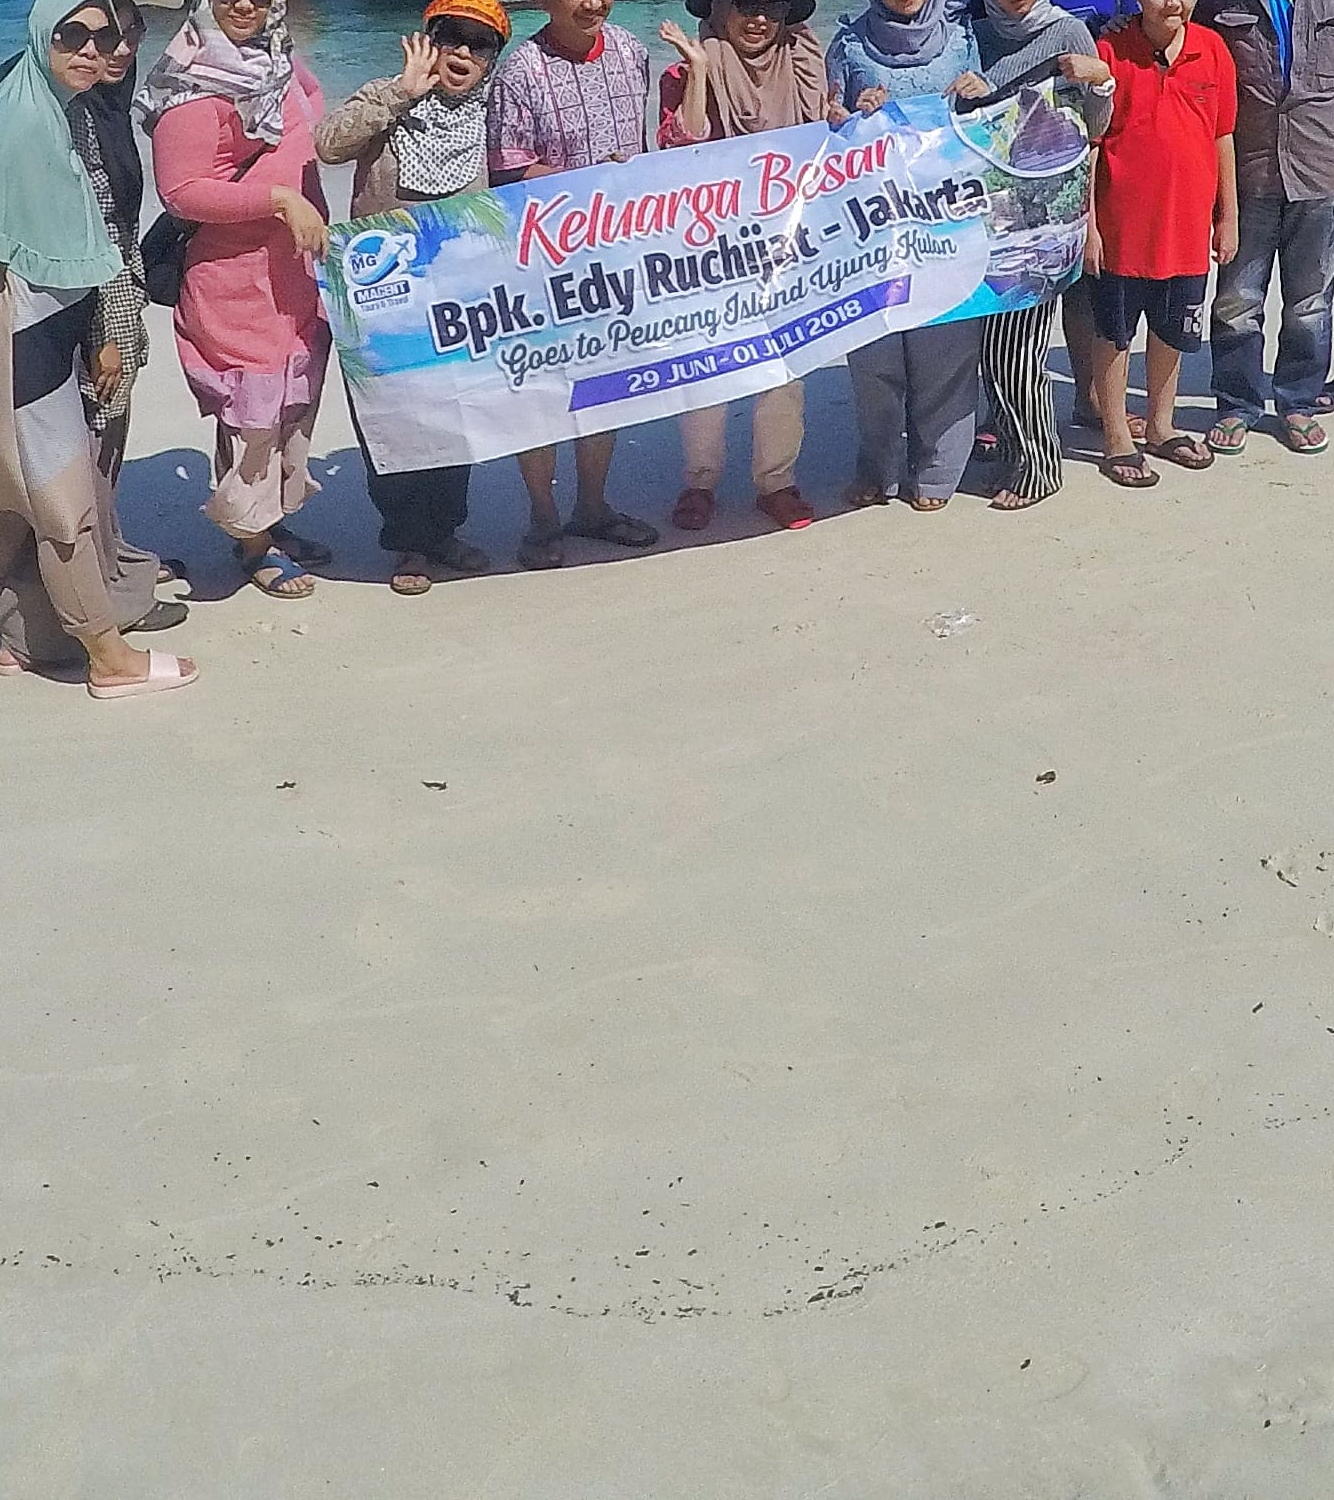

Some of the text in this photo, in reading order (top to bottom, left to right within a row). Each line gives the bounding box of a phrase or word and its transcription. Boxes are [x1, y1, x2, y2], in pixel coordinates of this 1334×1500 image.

[351, 255, 377, 270] MG
[431, 285, 545, 353] Bpk.
[549, 262, 634, 316] Edy
[643, 223, 820, 297] Ruchijat
[845, 178, 986, 242] Jakarta
[519, 134, 895, 266] Keluarga Besar
[501, 229, 957, 386] Goes to Peucang Island Ujung Kulon
[627, 370, 660, 392] 29
[666, 355, 716, 383] JUNI
[733, 343, 758, 364] 01
[763, 326, 805, 357] JULI
[806, 299, 863, 337] 2018
